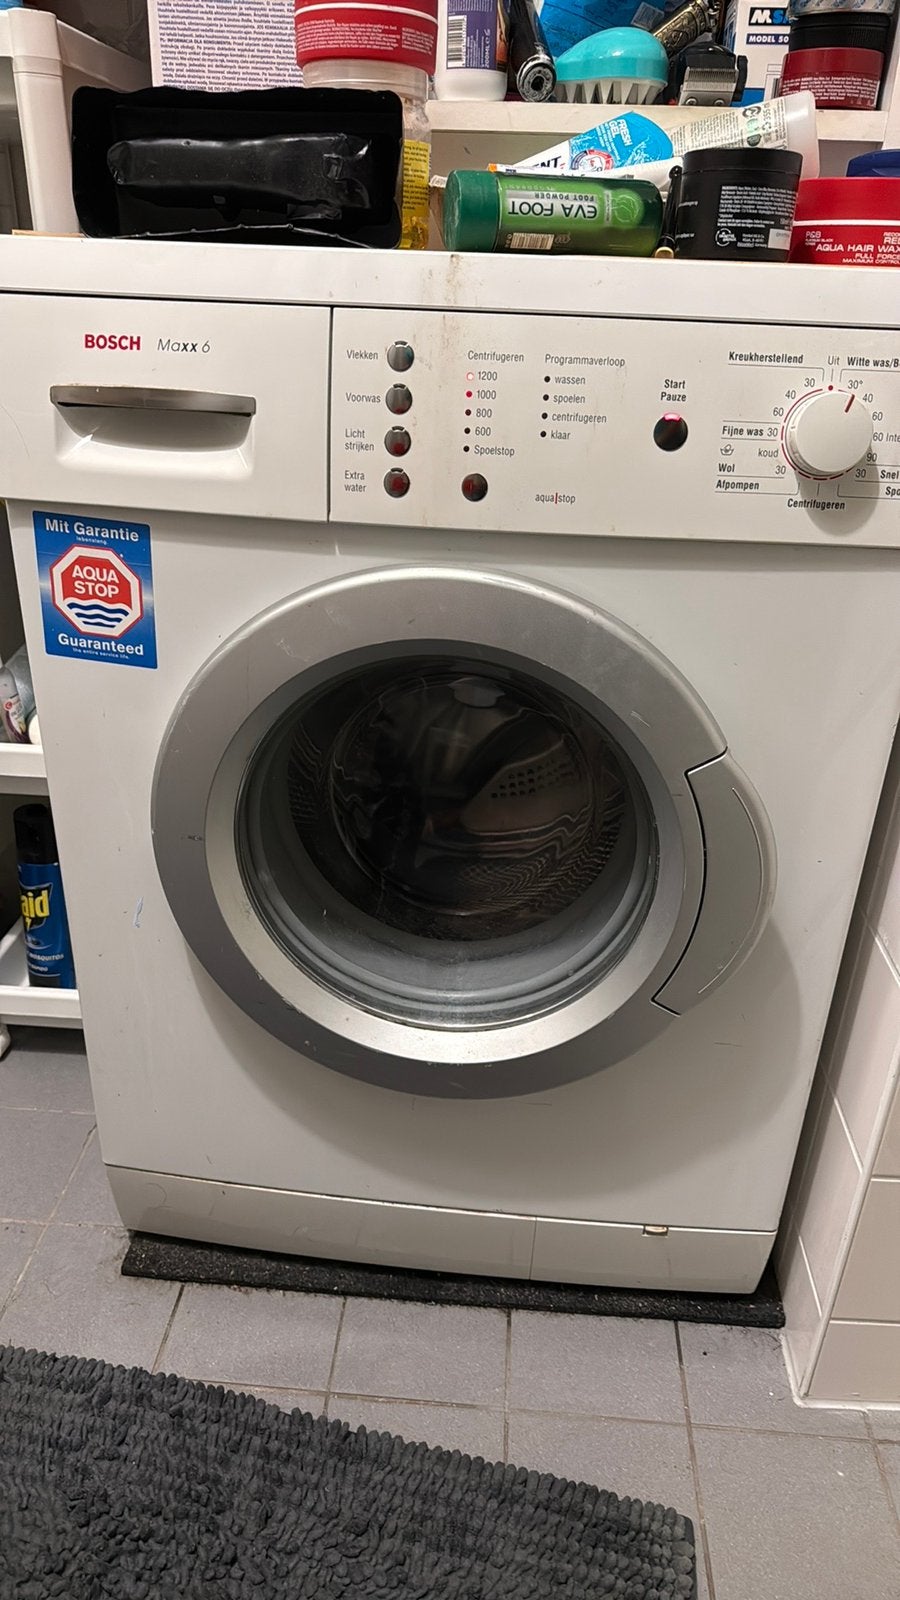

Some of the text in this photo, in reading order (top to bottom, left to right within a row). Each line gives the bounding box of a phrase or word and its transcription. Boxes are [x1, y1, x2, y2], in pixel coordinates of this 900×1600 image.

[748, 35, 776, 43] MODEL
[609, 120, 620, 138] GEL
[617, 119, 633, 147] FRESH
[535, 192, 595, 202] FOOT POWDER
[508, 201, 554, 217] FOOT
[561, 203, 598, 218] EVA
[816, 244, 844, 252] AQUA
[847, 244, 874, 253] HAIR
[877, 245, 900, 253] WAX
[84, 334, 141, 350] BOSCH
[157, 338, 211, 353] Maxx 6
[346, 349, 379, 360] Vlekken
[467, 350, 525, 363] Centrifugeren
[728, 351, 804, 364] Kreukherstellend
[544, 353, 626, 368] Programmaverloop
[827, 355, 840, 366] Uit
[847, 356, 870, 367] Witte
[477, 371, 498, 381] 1200
[554, 375, 586, 385] wassen
[663, 378, 686, 389] Start
[803, 377, 816, 388] 30
[345, 392, 381, 403] Voorwas
[476, 389, 497, 400] 1000
[553, 394, 586, 405] spoelen
[660, 391, 687, 402] Pauze
[784, 389, 797, 400] 40
[862, 393, 874, 403] 40
[475, 408, 493, 418] 800
[772, 407, 784, 417] 60
[871, 411, 883, 421] 60
[551, 412, 607, 424] centrifugeren
[344, 428, 366, 439] Licht
[474, 426, 492, 437] 600
[550, 430, 571, 440] klaar
[721, 425, 779, 437] Fijne was 30
[872, 432, 884, 442] 60
[344, 442, 375, 453] strijken
[473, 444, 515, 457] Spoelstop
[757, 448, 779, 458] koud
[866, 452, 877, 462] 90
[718, 462, 787, 475] Wol 30
[855, 468, 899, 479] 30 Snel
[344, 469, 365, 480] Extra
[344, 483, 367, 493] water
[715, 479, 760, 492] Afpompen
[787, 498, 846, 511] Centrifugeren
[45, 518, 139, 542] Mit Garantie
[72, 564, 119, 584] AQUA
[74, 580, 119, 598] STOP
[57, 633, 144, 656] Guaranteed
